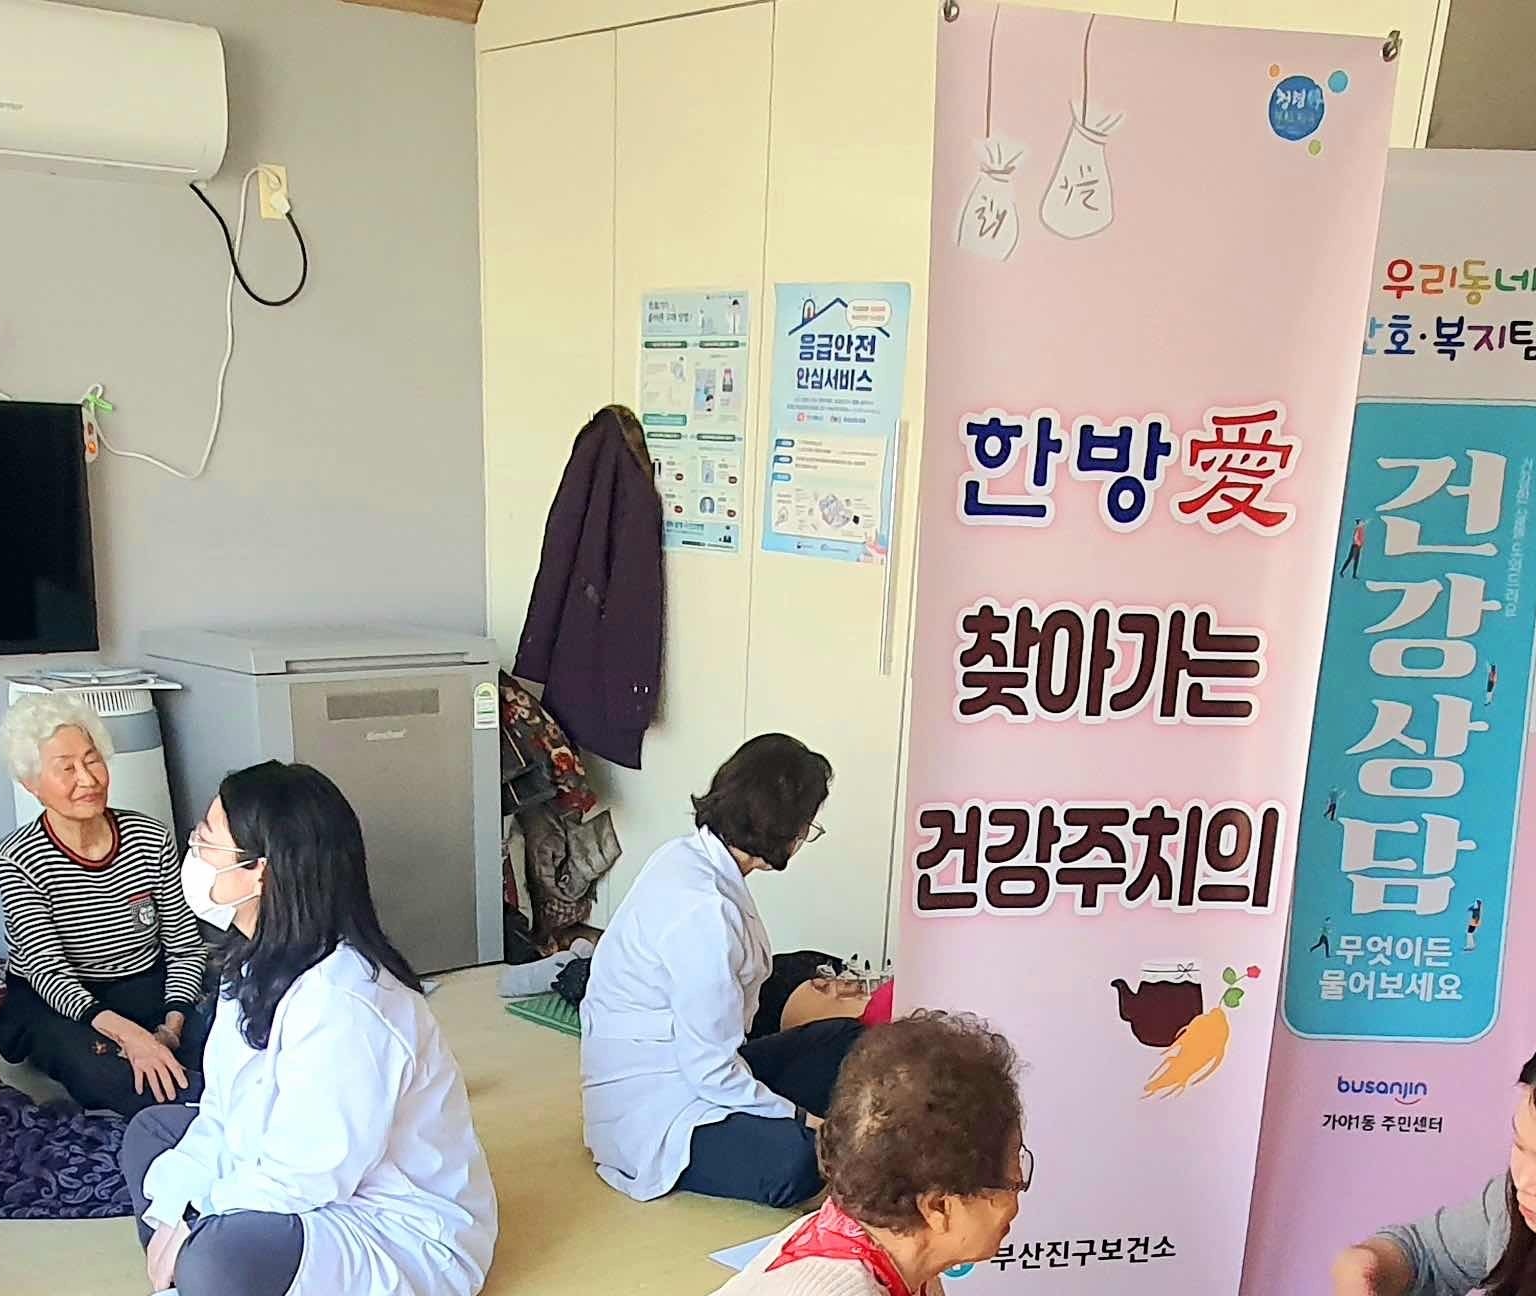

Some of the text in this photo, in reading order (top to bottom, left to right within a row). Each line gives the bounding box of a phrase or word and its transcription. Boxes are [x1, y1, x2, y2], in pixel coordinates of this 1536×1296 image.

[798, 333, 877, 363] 응급안전
[796, 367, 873, 392] 안심서비스
[964, 409, 1294, 528] 한방愛
[959, 604, 1261, 718] 찾아가는
[1339, 449, 1508, 915] 건강상담
[916, 805, 1281, 911] 건강주치의
[1335, 935, 1453, 967] 무엇이든
[1318, 969, 1463, 1002] 물어보세요
[1337, 1076, 1428, 1100] busanjin
[1322, 1114, 1444, 1133] 가야1동 주민센터
[990, 1235, 1177, 1272] 부산진구보건소
